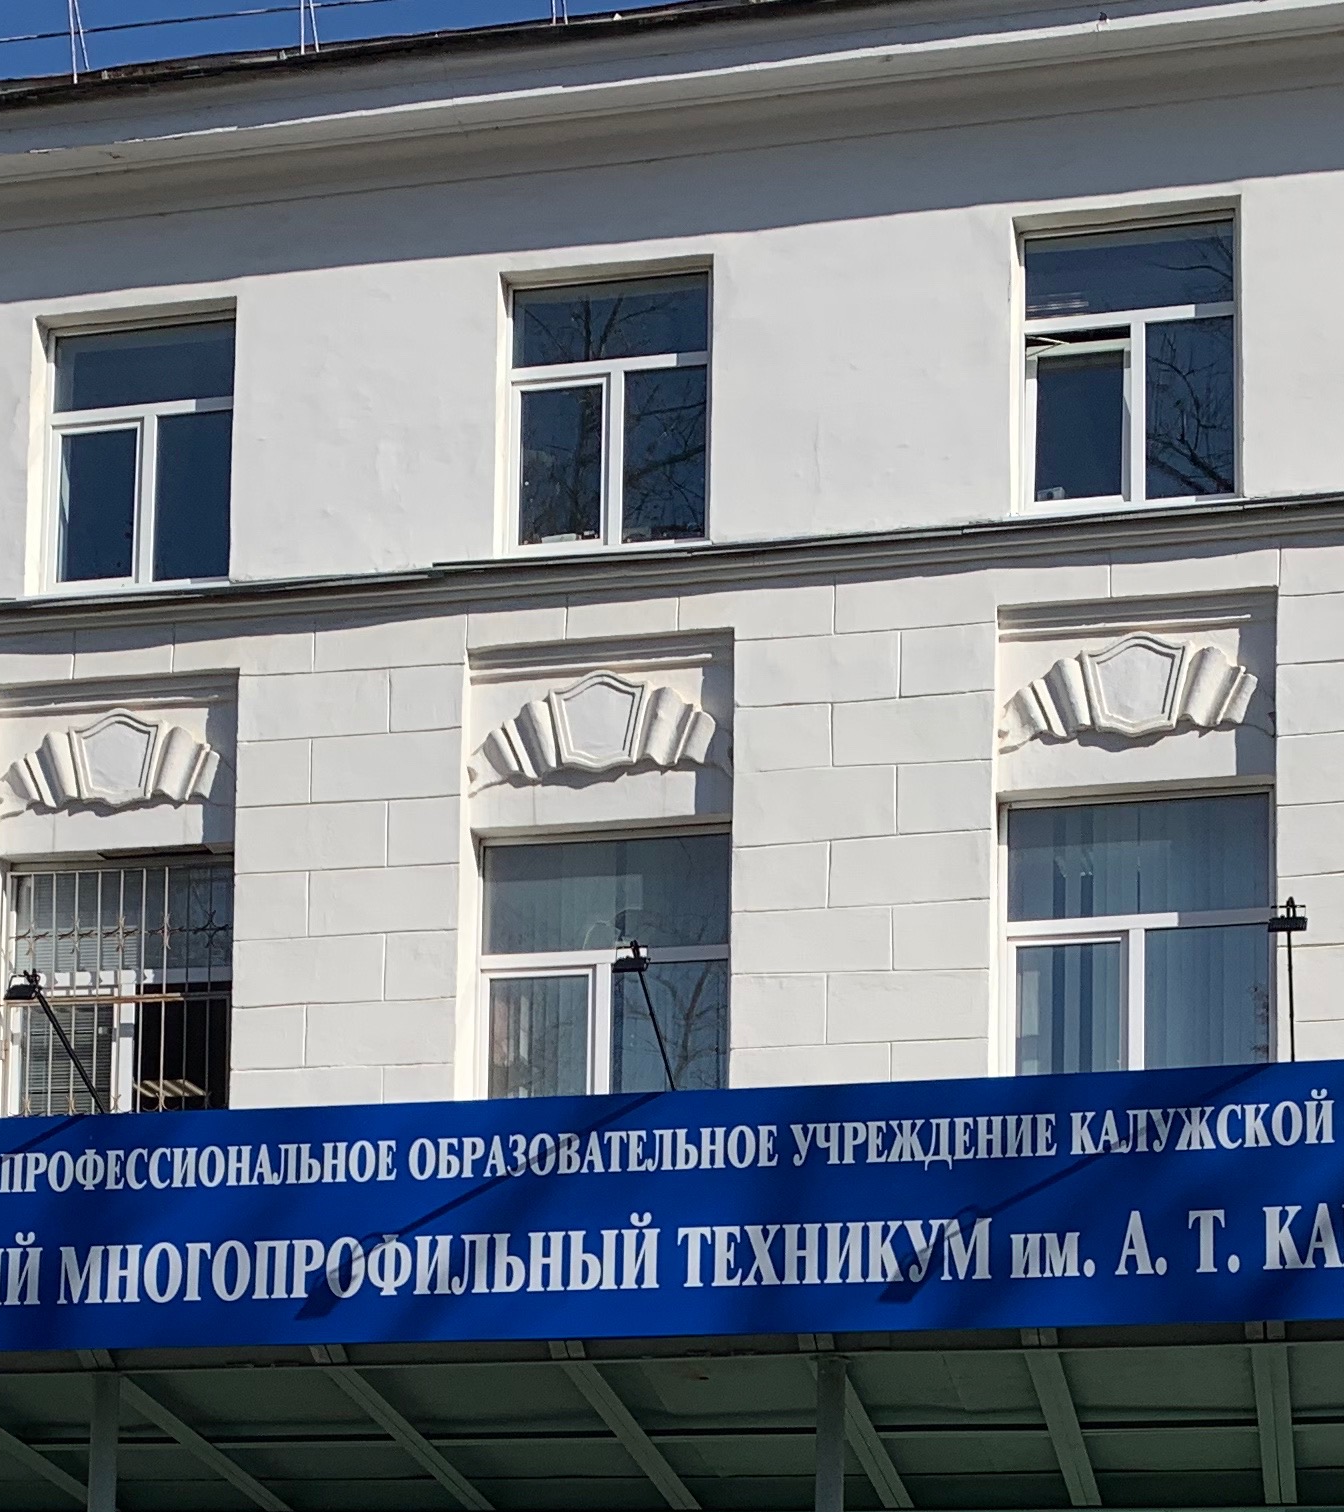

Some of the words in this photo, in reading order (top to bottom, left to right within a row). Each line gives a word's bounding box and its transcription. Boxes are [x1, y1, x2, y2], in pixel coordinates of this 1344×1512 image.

[0, 1140, 397, 1192] ПРОФЕССИОНАЛЬНОЕ
[409, 1126, 779, 1181] ОБРАЗОВАТЕЛЬНОЕ
[791, 1113, 1057, 1171] УЧРЕЖДЕНИЕ
[1070, 1089, 1335, 1155] КАЛУЖСКОЙ
[58, 1211, 661, 1304] МНОГОПРОФИЛЬНЫЙ
[678, 1217, 993, 1288] ТЕХНИКУМ
[1011, 1231, 1096, 1279] им.
[1115, 1210, 1168, 1276] А.
[1189, 1209, 1240, 1274] Т.
